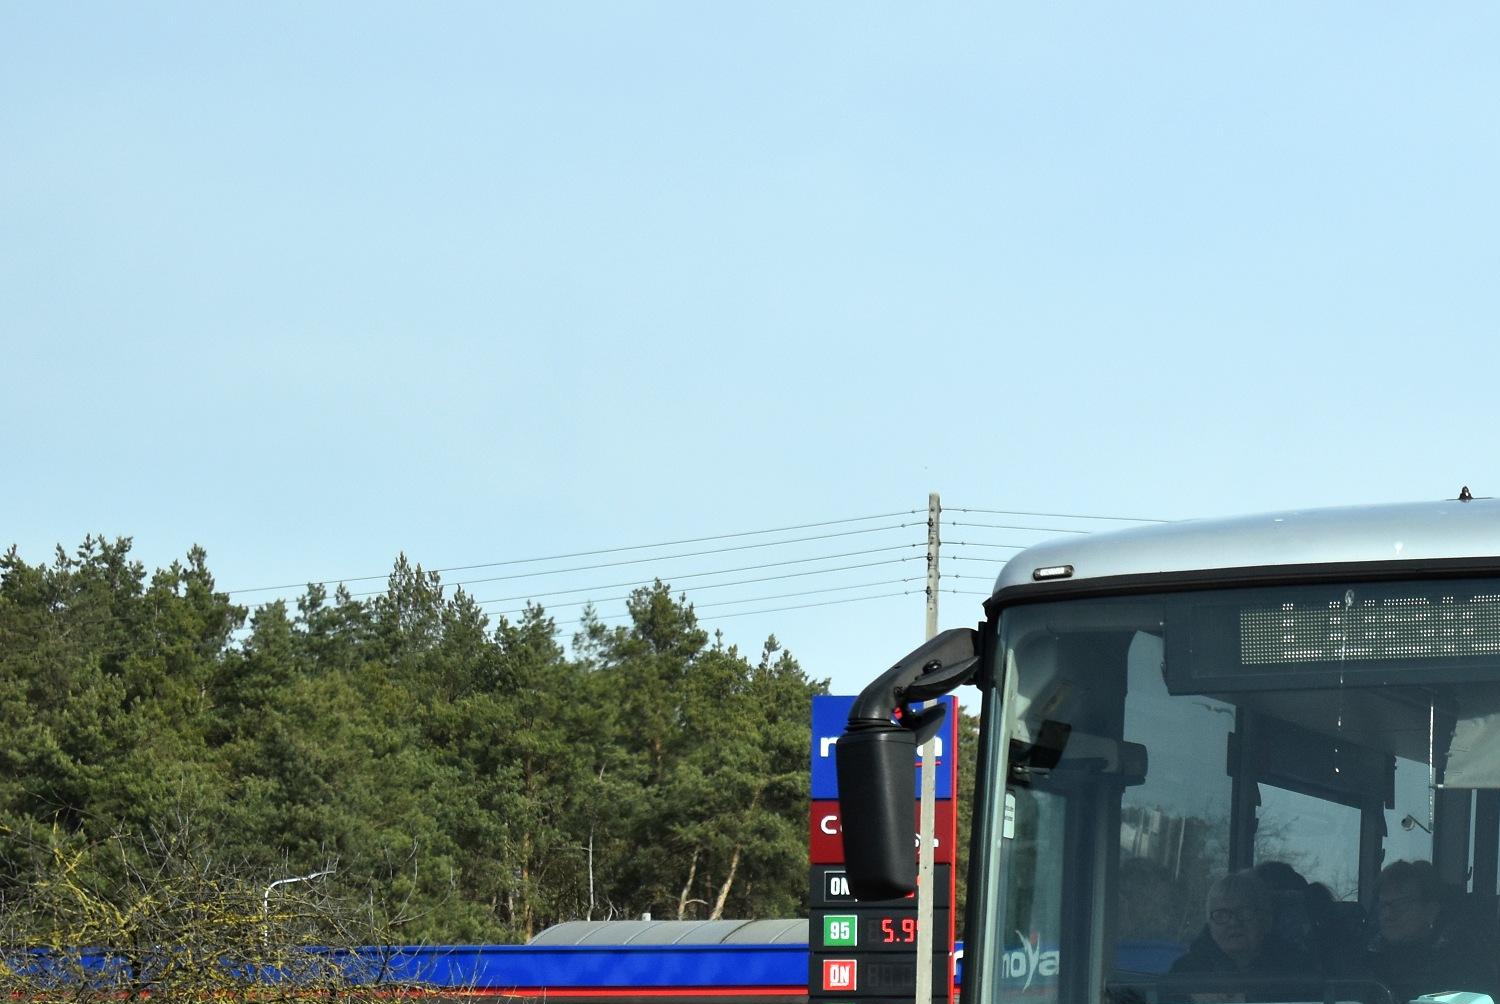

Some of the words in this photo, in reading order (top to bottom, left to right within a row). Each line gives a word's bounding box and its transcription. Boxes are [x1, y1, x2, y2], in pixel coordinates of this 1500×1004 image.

[830, 921, 850, 940] 95
[881, 918, 920, 943] 5.9
[829, 964, 850, 983] ON
